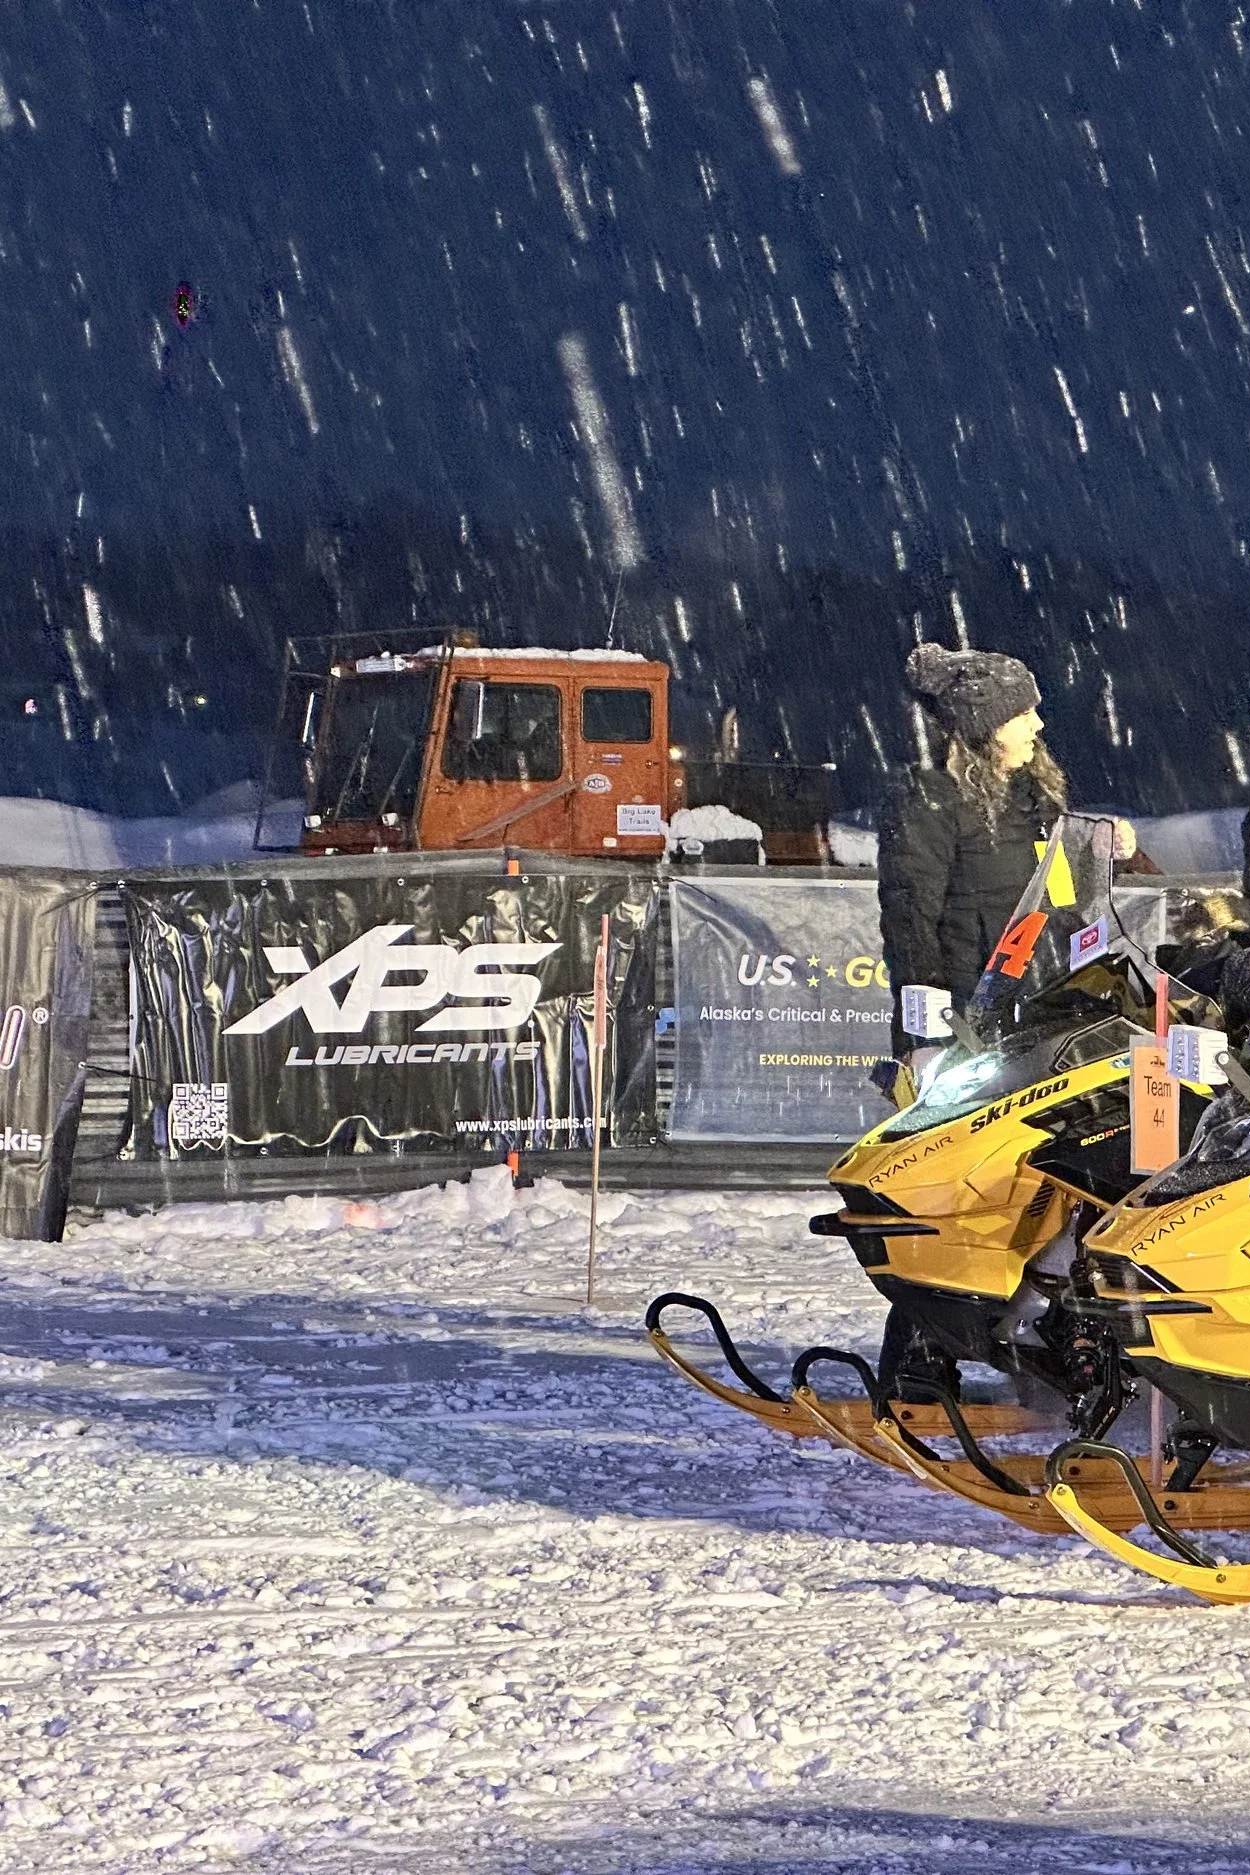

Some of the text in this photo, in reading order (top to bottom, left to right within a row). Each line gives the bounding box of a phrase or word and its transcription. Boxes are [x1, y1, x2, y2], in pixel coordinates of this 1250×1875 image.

[222, 924, 563, 1034] XPS
[738, 954, 797, 987] U.S.
[768, 1007, 826, 1023] Critical
[829, 1009, 842, 1023] &
[285, 1041, 541, 1066] LUBRICANTS
[759, 1054, 833, 1066] EXPLORING
[836, 1056, 858, 1066] THE
[1144, 1076, 1172, 1098] Team
[455, 1115, 607, 1135] www.xpslubricants.cm
[1153, 1108, 1165, 1127] 44
[0, 1127, 42, 1151] kis
[868, 1135, 953, 1188] RYAN AIR
[1131, 1192, 1227, 1258] RYAN AIR
